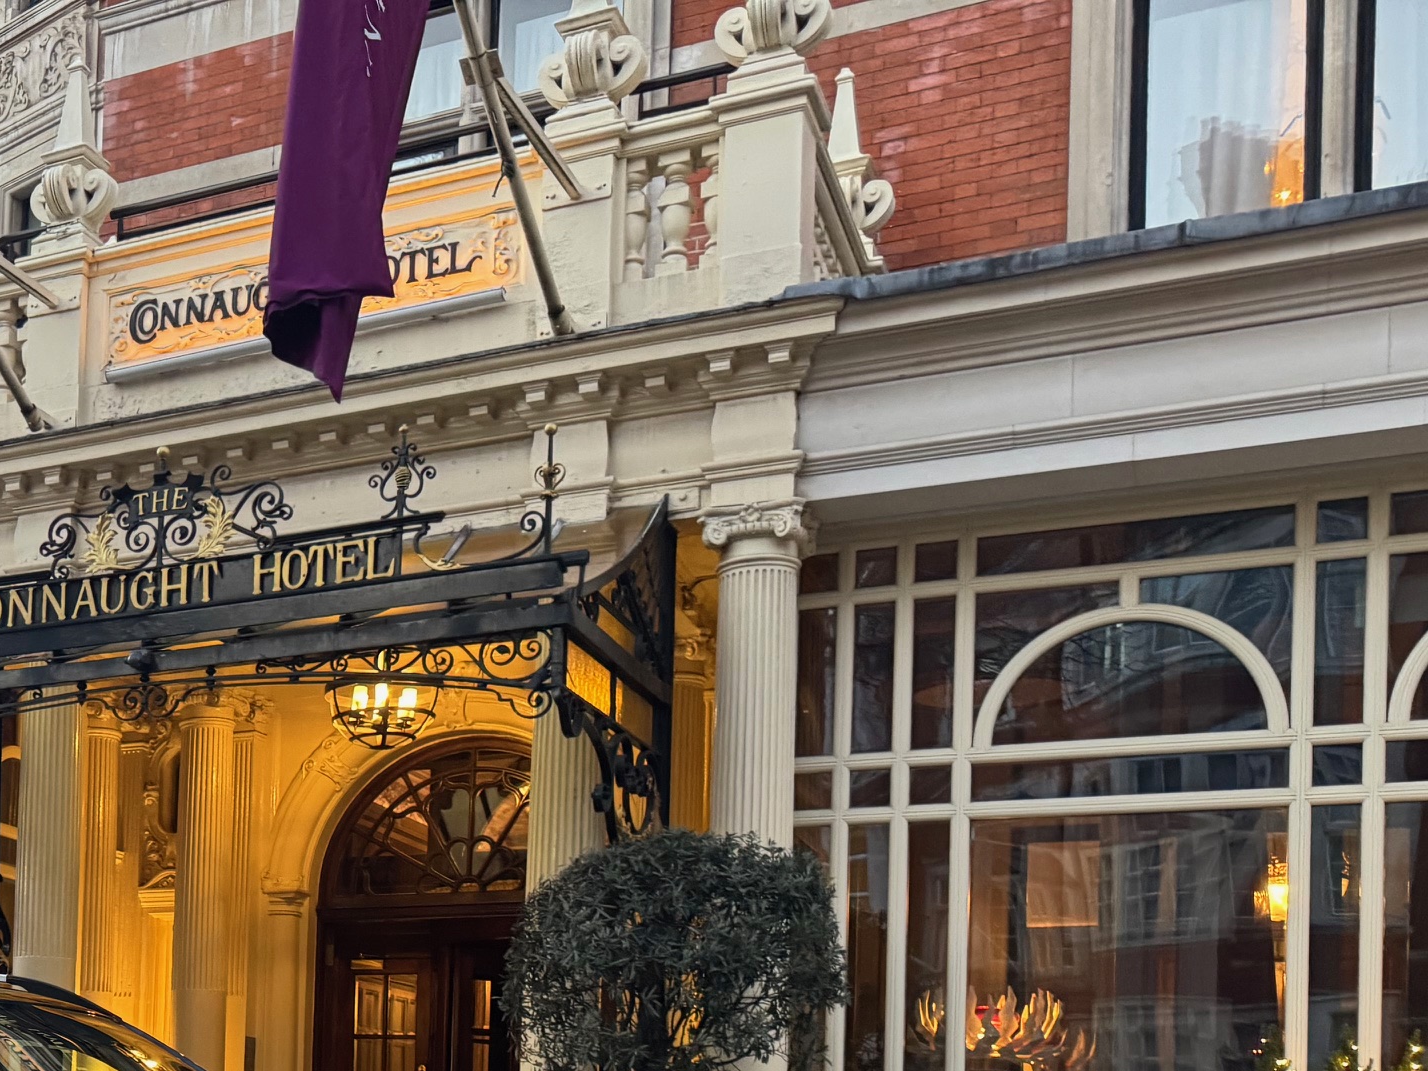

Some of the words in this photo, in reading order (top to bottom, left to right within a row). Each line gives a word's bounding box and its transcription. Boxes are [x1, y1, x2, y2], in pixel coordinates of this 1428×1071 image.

[129, 279, 270, 344] CONNAUG
[386, 240, 482, 286] OTEL
[132, 486, 191, 516] THE
[252, 537, 396, 596] HOTEL
